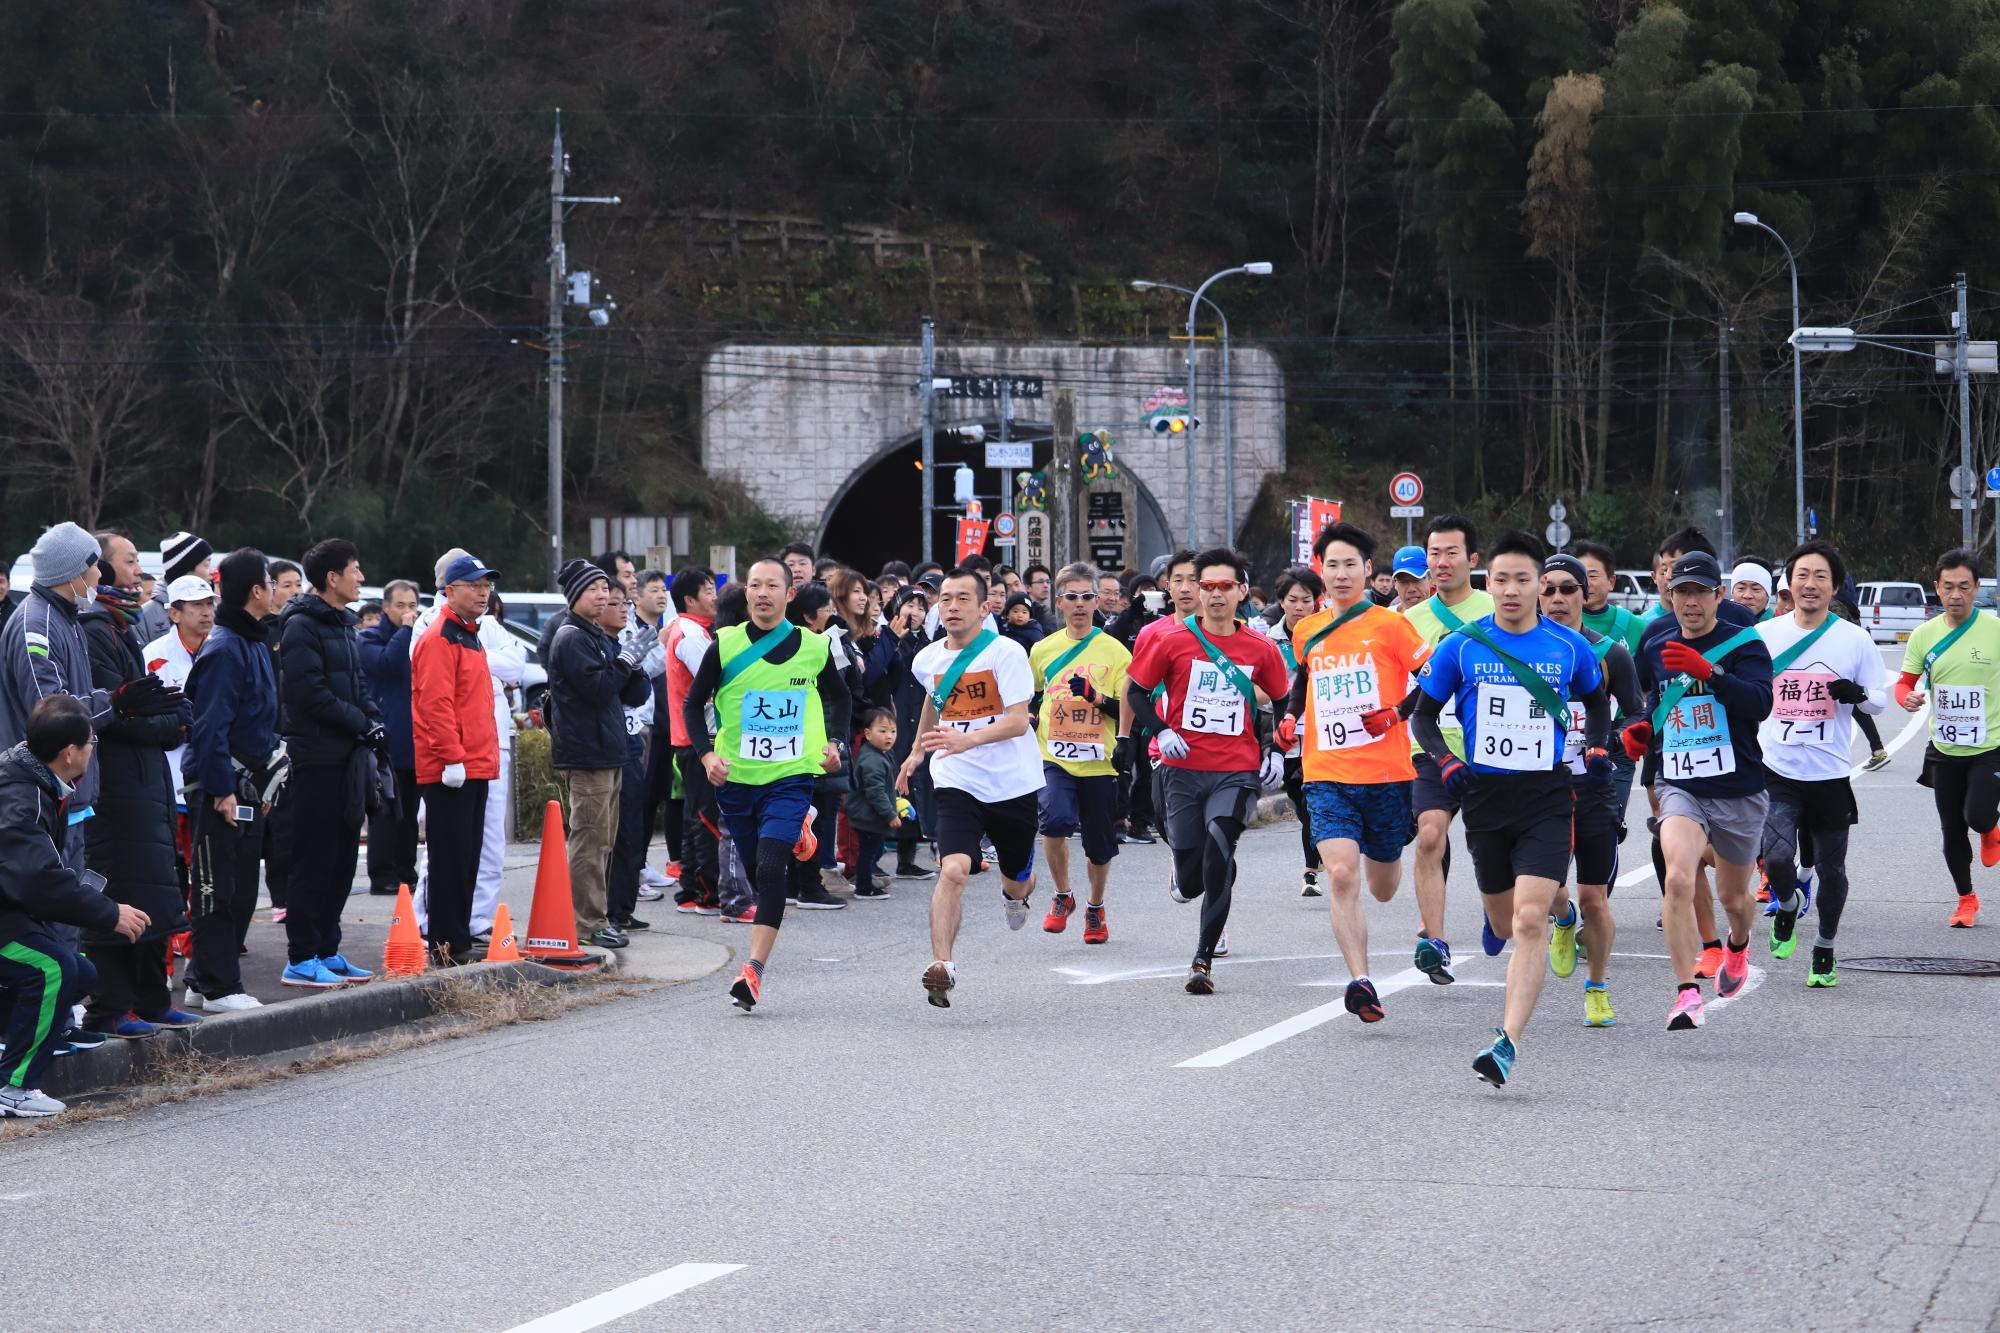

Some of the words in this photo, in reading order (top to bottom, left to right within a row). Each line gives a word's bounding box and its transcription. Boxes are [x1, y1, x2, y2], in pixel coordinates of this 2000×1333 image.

[1398, 482, 1415, 496] 40
[1000, 519, 1014, 531] 50
[1474, 663, 1504, 675] FUJI
[1316, 670, 1373, 702] 岡野B
[1778, 679, 1828, 703] 福住
[749, 696, 799, 720] 大山
[1053, 703, 1105, 726] 今田B
[1667, 702, 1716, 734] 味間
[1190, 707, 1237, 733] 5-1
[1779, 720, 1826, 741] 7-1
[1938, 724, 1979, 744] 18-1
[748, 736, 797, 759] 13-1
[1053, 741, 1099, 759] 22-1
[1484, 735, 1543, 759] 30-1
[1670, 747, 1724, 777] 14-1
